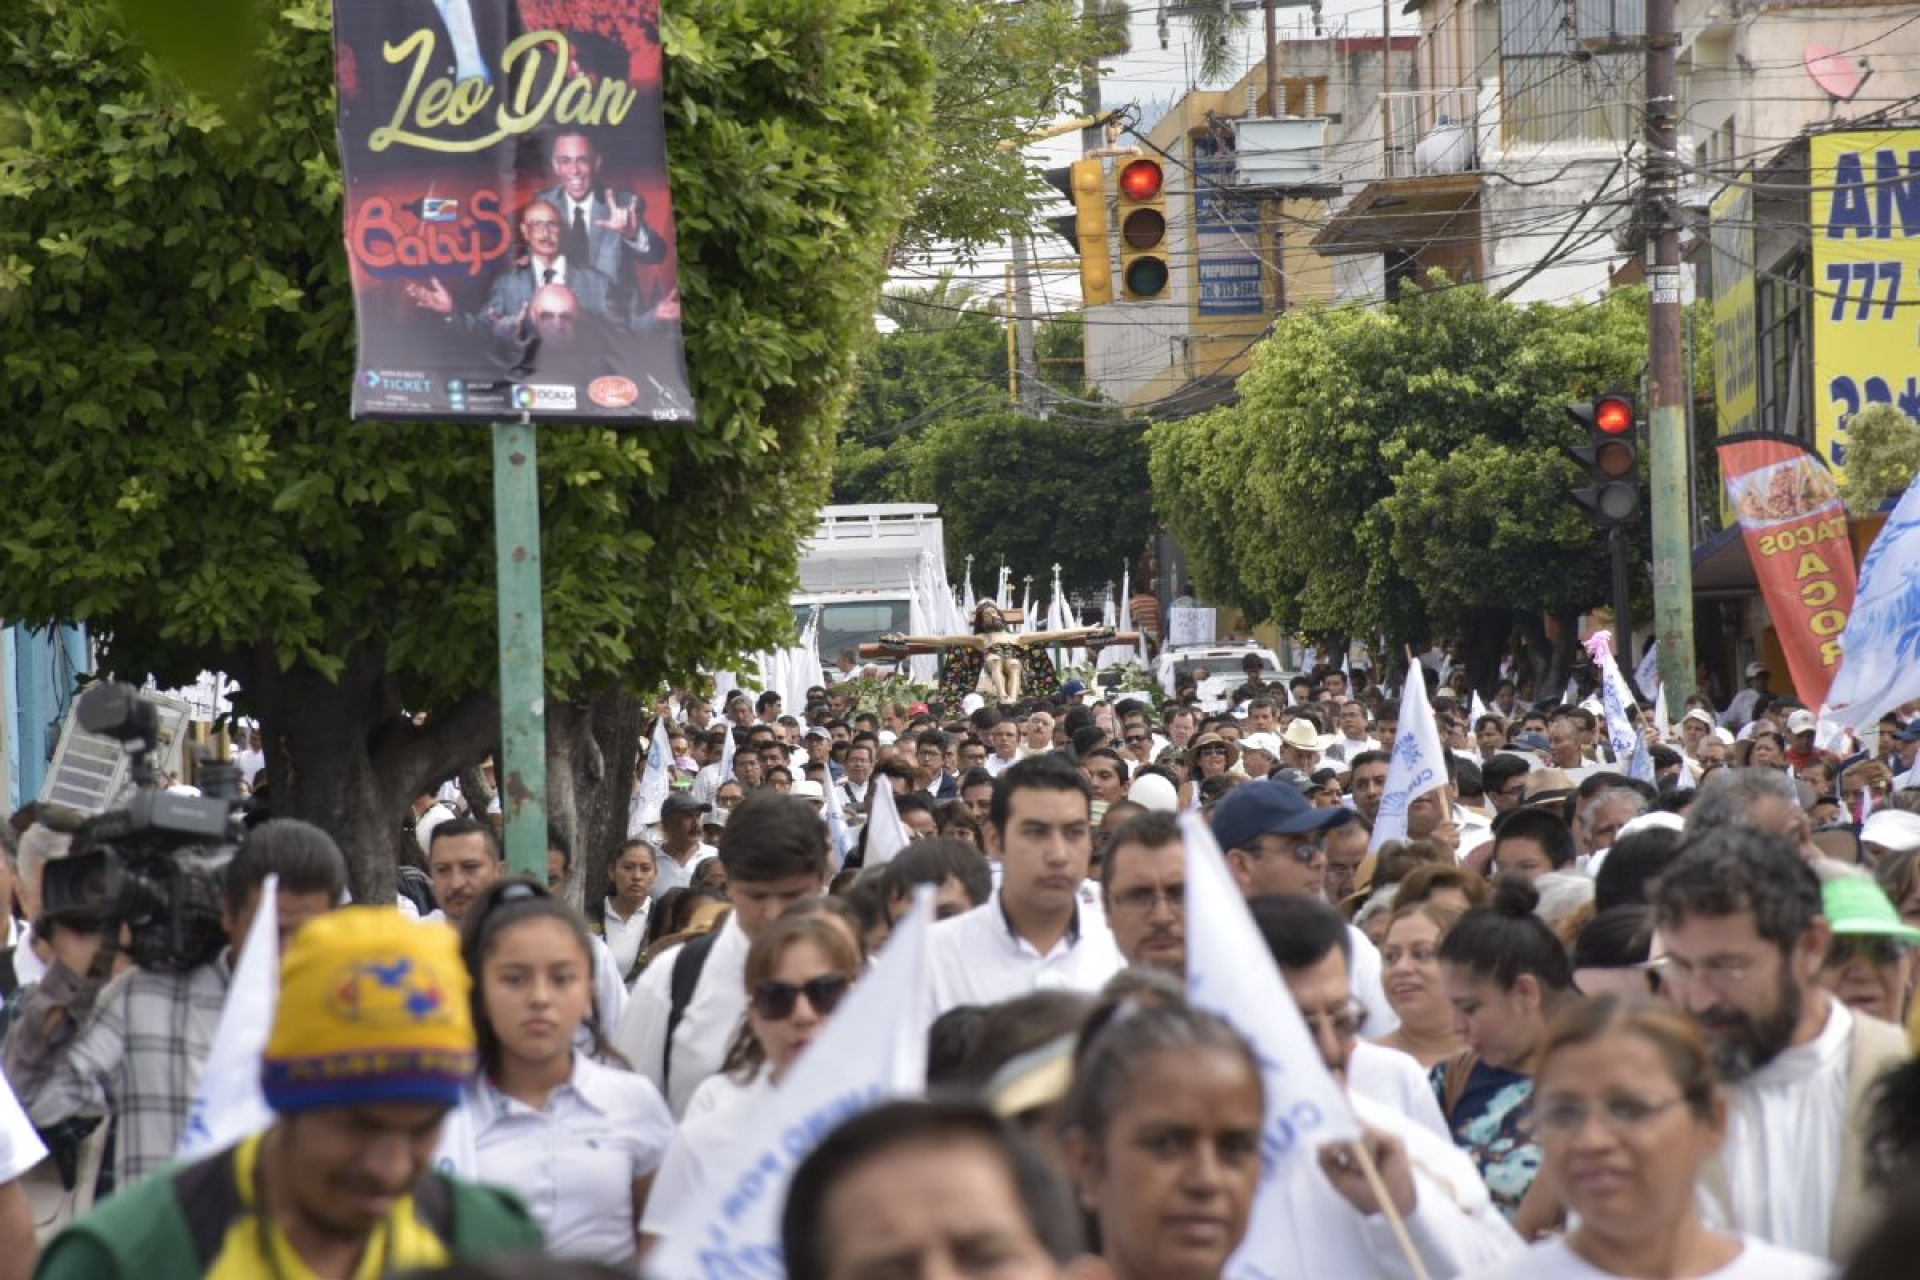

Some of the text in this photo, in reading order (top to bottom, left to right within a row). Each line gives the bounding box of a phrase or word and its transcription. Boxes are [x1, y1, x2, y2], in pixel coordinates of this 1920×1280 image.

[368, 28, 638, 153] Leo Dan
[1825, 262, 1902, 322] 777
